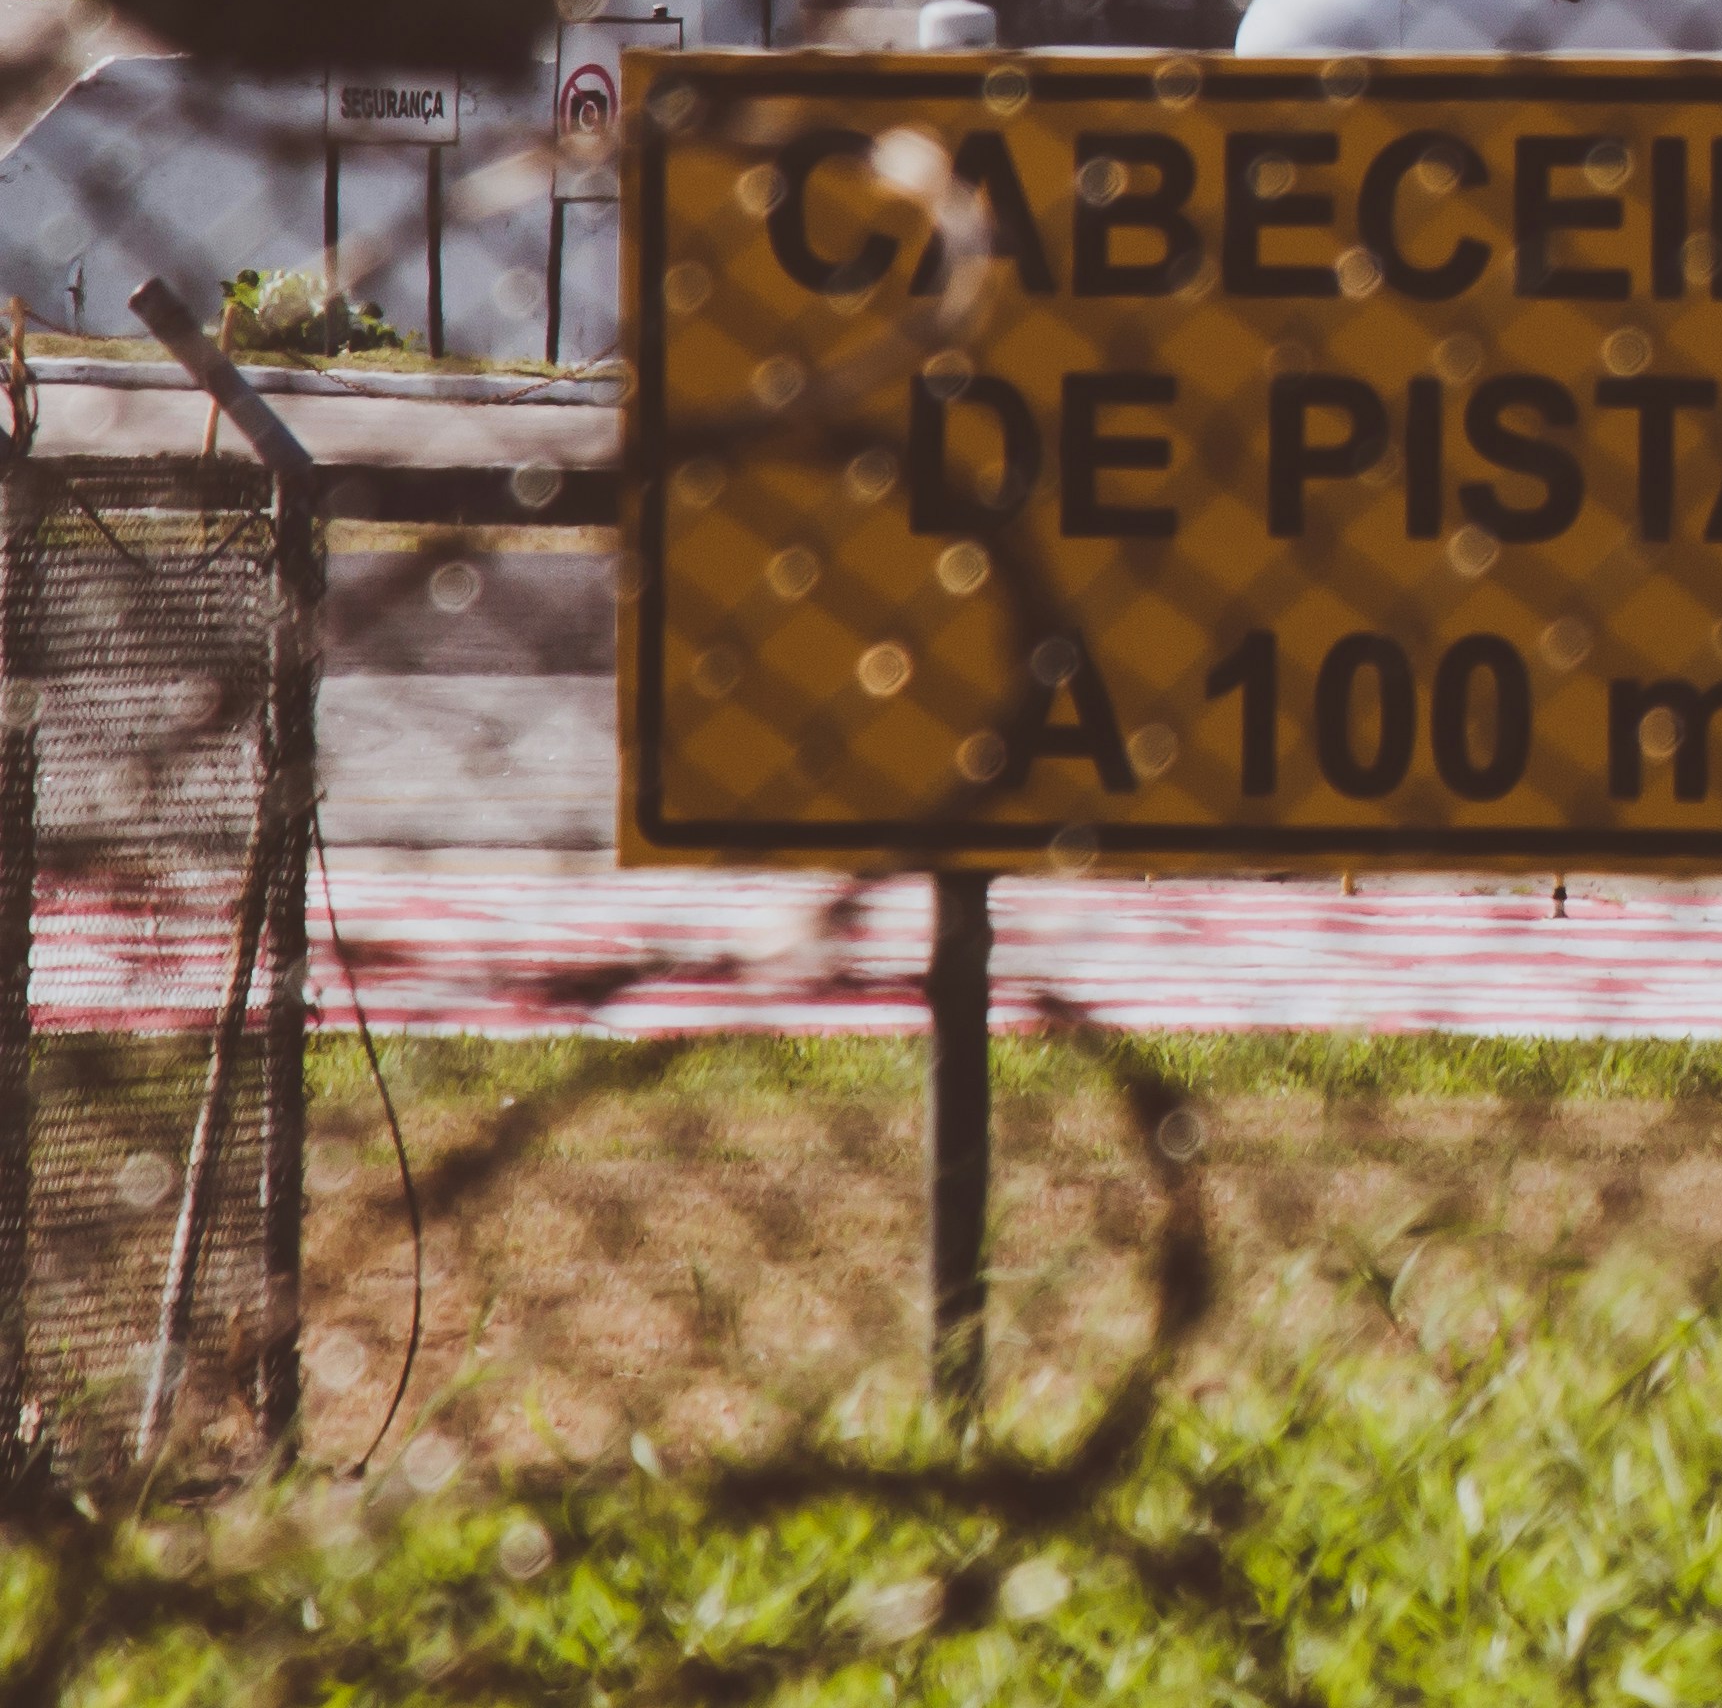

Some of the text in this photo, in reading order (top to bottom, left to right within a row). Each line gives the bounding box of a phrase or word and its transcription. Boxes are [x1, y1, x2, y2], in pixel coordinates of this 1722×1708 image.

[341, 88, 445, 124] SEGURANÇA
[908, 372, 1180, 539] DE
[1000, 627, 1138, 796] A
[1205, 629, 1534, 804] 100
